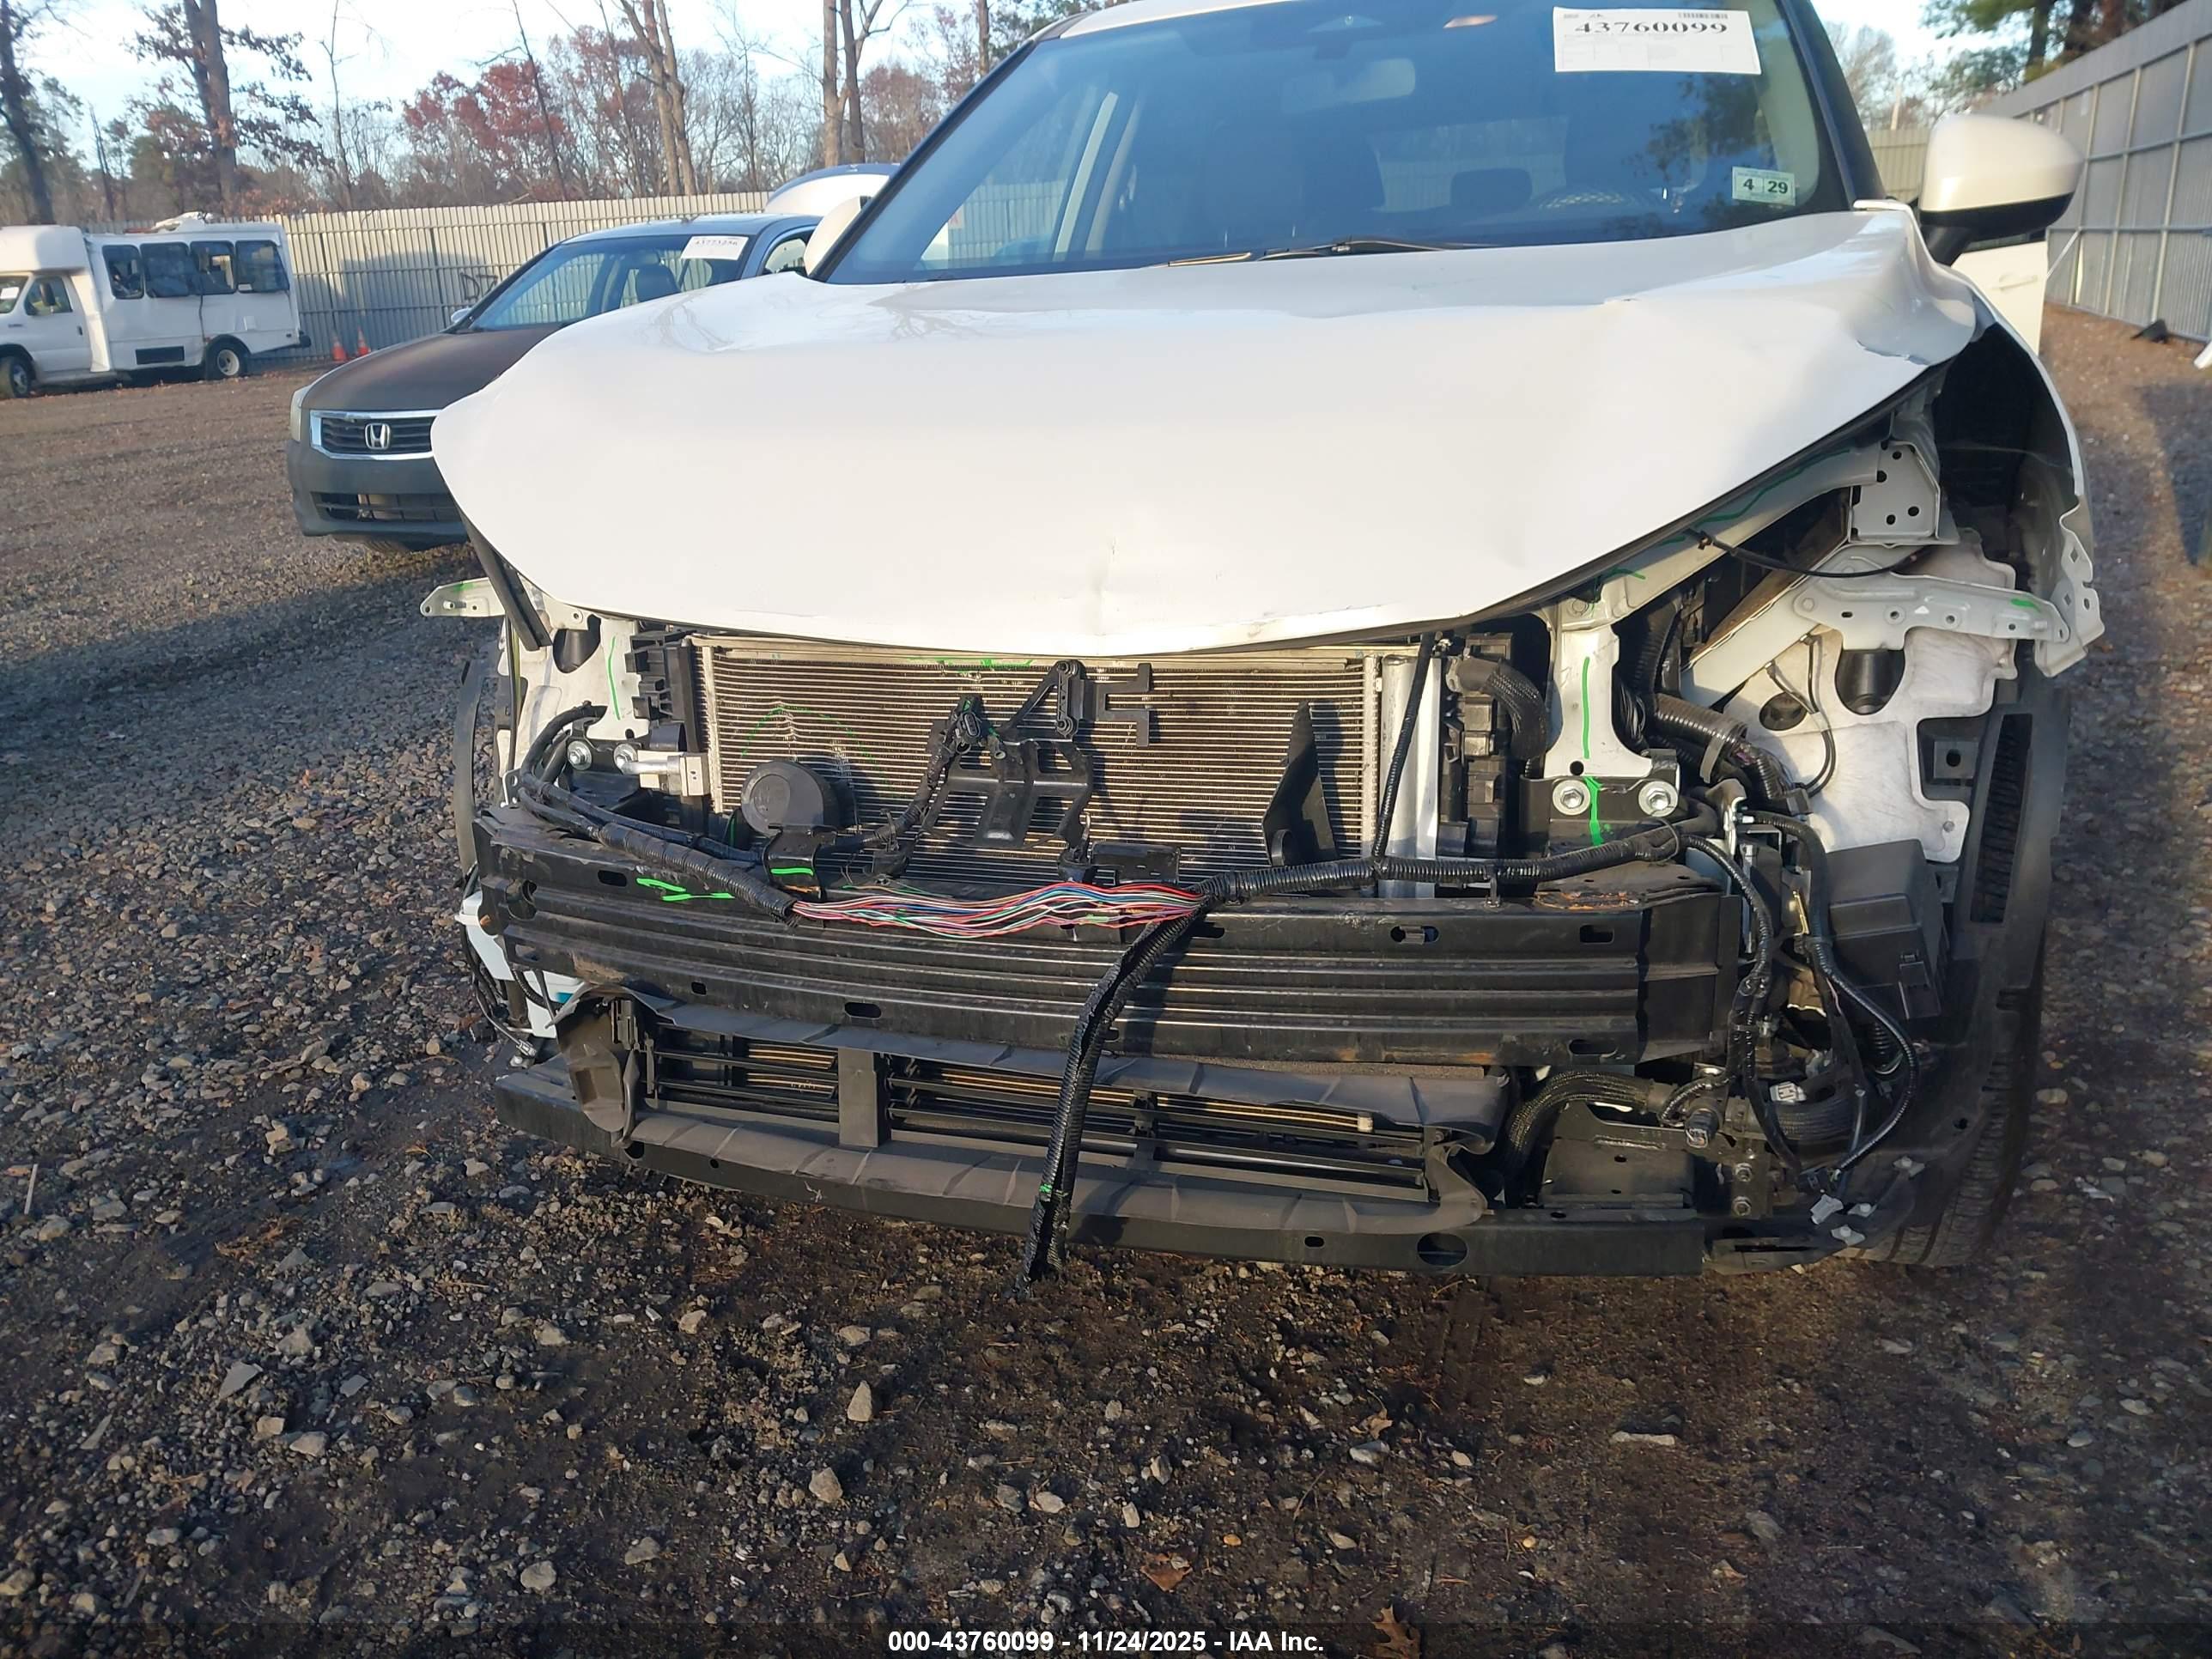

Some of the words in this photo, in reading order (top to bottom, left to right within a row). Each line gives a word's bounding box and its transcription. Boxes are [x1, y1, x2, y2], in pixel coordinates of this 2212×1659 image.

[1575, 21, 1728, 33] 43760099
[1743, 178, 1753, 190] 4
[1767, 180, 1788, 194] 29
